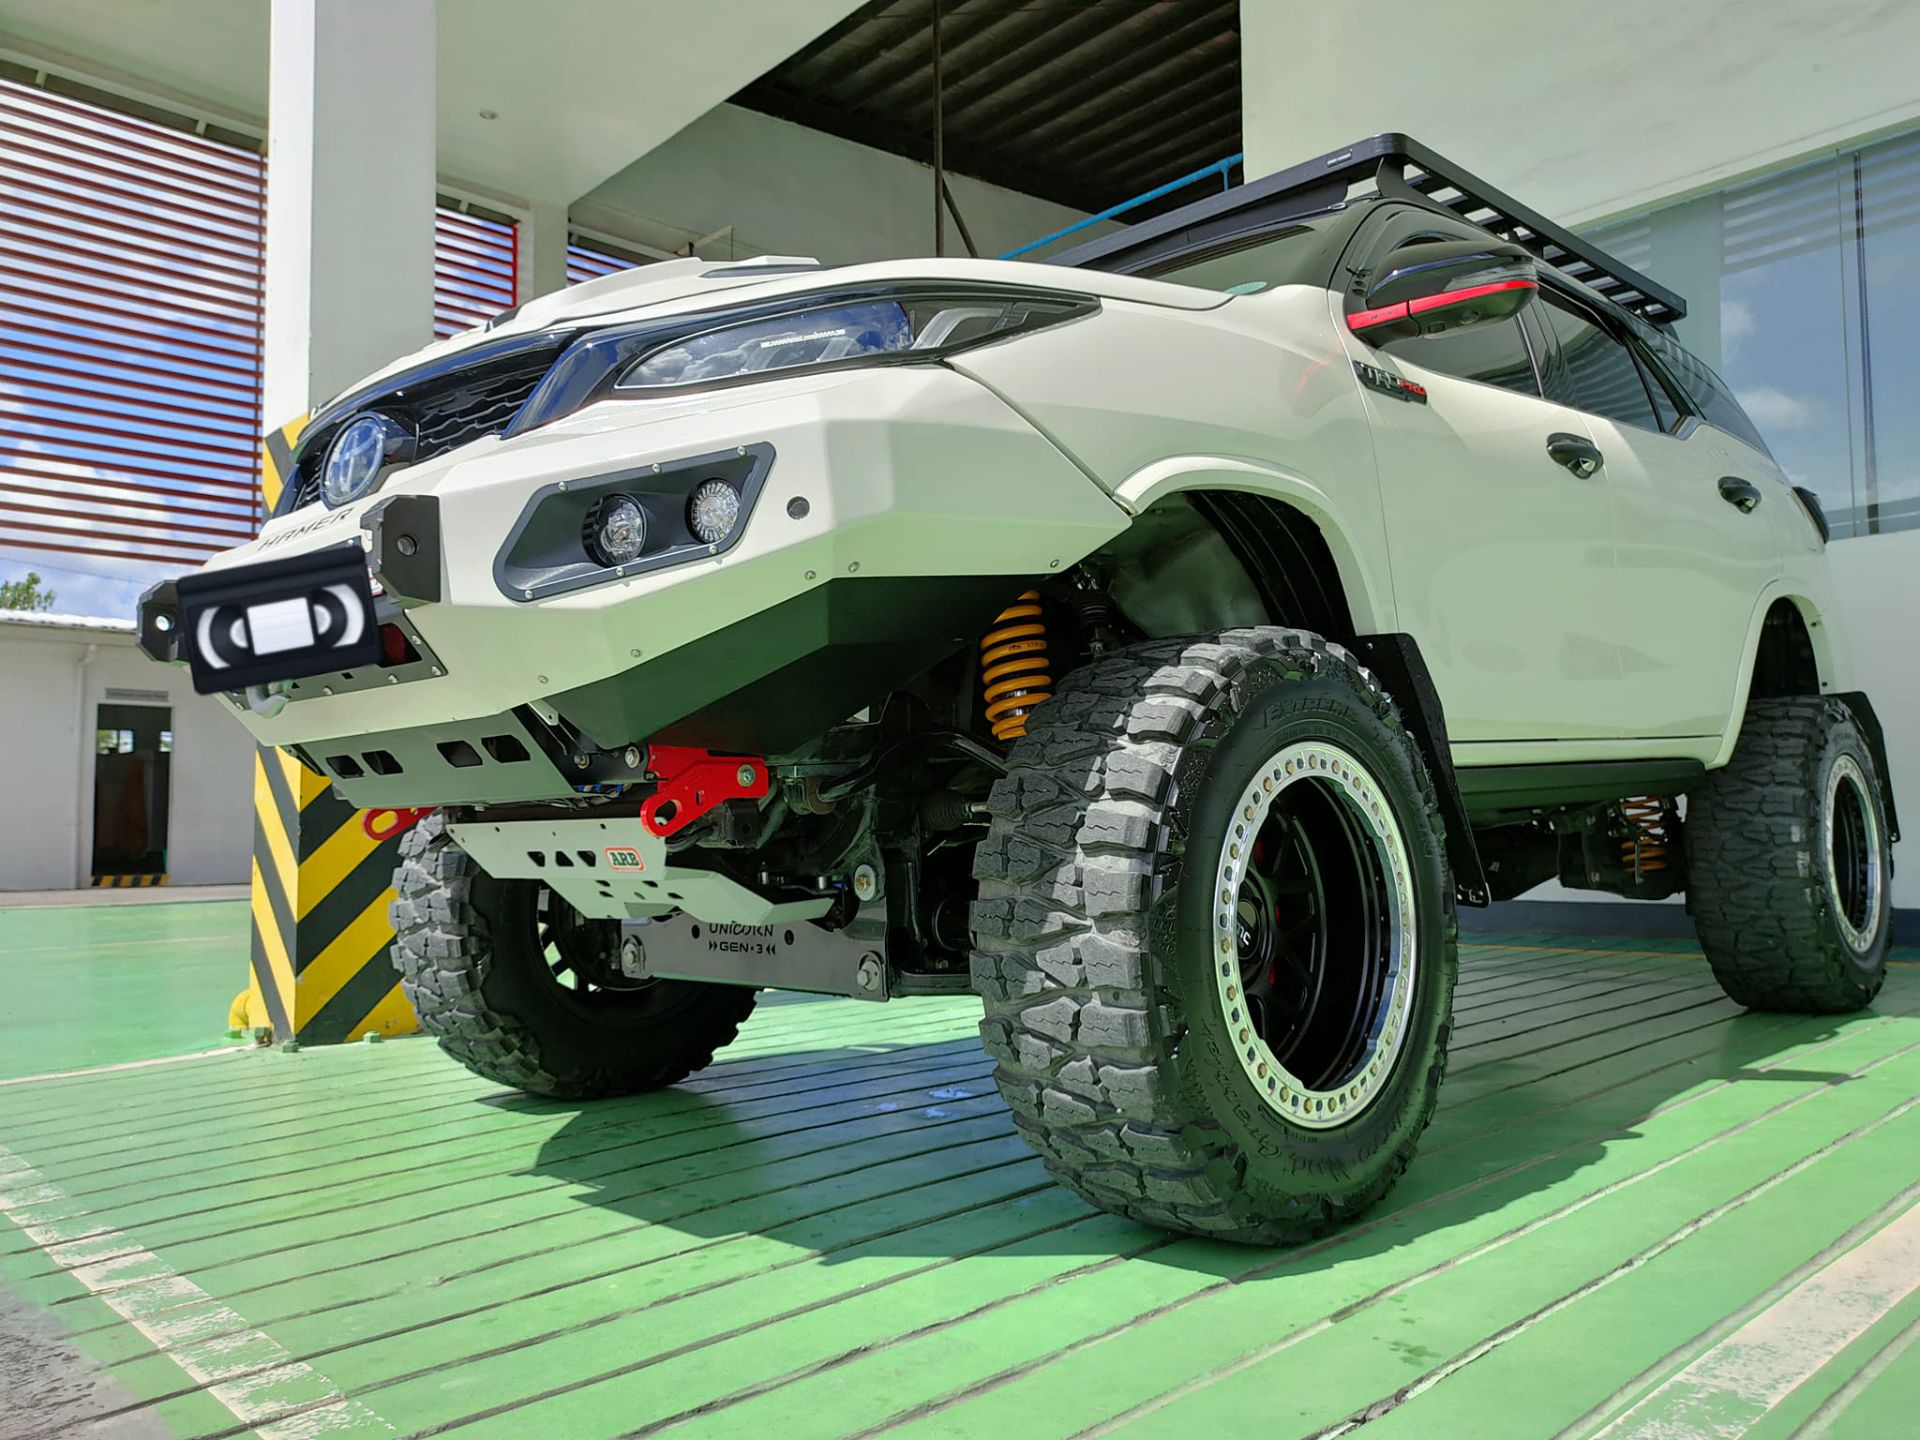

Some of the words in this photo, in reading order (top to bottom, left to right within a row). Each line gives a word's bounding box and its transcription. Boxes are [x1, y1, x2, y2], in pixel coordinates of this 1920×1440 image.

[257, 507, 354, 552] HAMER
[610, 852, 640, 867] ARB
[709, 923, 774, 937] UNICORN
